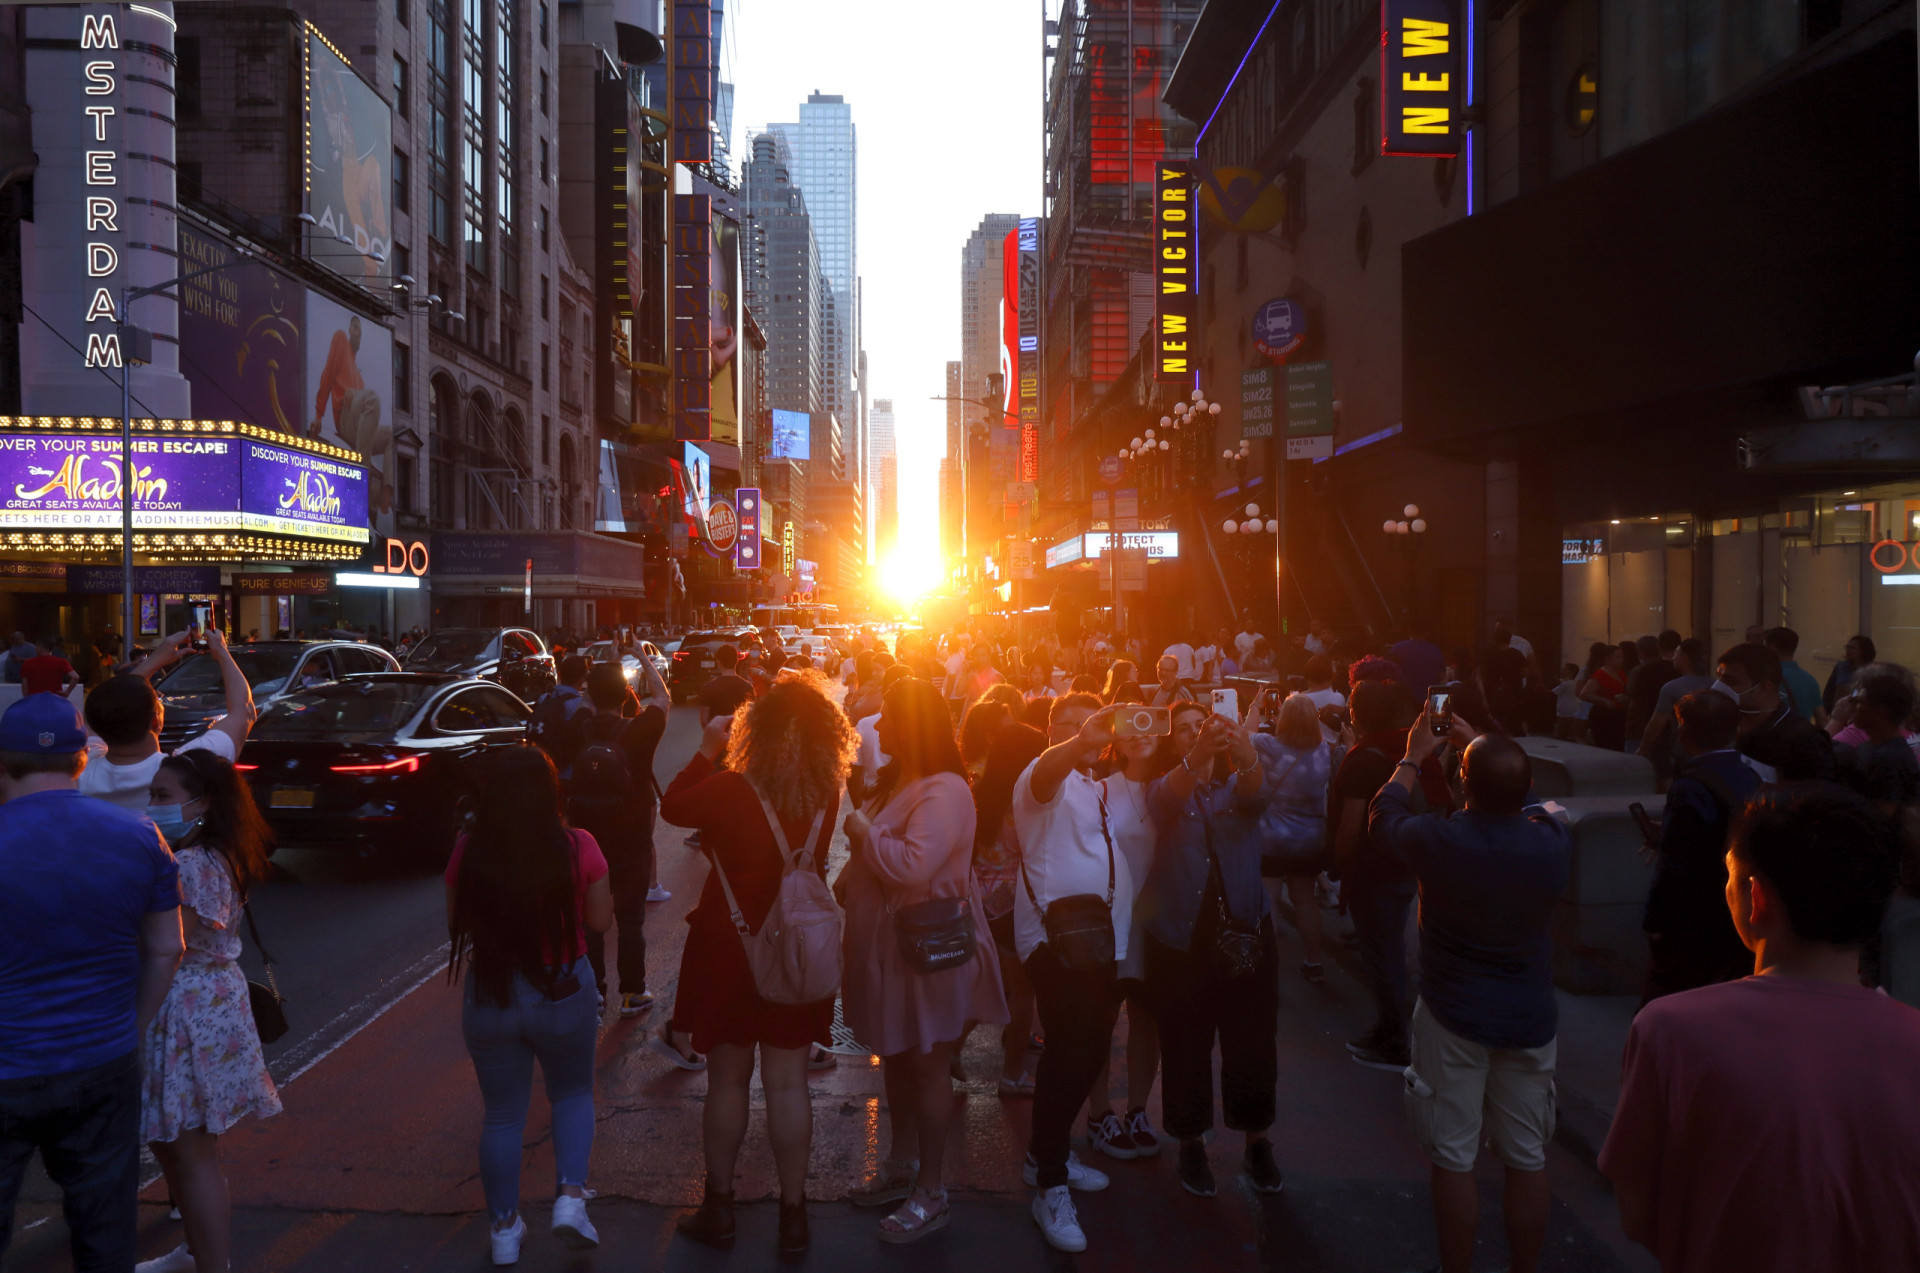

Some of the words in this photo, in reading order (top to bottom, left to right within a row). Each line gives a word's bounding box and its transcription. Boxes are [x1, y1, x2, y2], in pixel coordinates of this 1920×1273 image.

[678, 0, 706, 160] ADAME
[1402, 18, 1450, 135] NEW
[81, 14, 122, 368] MSTERDAM
[1019, 218, 1037, 251] NEW
[1163, 169, 1187, 294] VICTORY
[184, 259, 213, 292] WHAT
[219, 275, 238, 303] YOU
[184, 285, 212, 317] WISH
[681, 195, 704, 437] TUSSAUDS
[1163, 314, 1187, 373] NEW
[1257, 343, 1267, 353] NO
[1268, 336, 1302, 355] STANDING
[1243, 370, 1267, 385] SIM8
[1021, 378, 1037, 414] DUE
[1243, 387, 1272, 403] SIM22
[1243, 422, 1272, 438] SIM30
[41, 440, 86, 451] YOUR
[91, 441, 159, 453] SUMMER
[163, 442, 228, 454] ESCAPE!
[251, 446, 289, 464] DISCOVER
[290, 456, 310, 468] YOUR
[310, 461, 337, 475] SUMMER
[337, 466, 362, 480] ESCAPE!
[15, 454, 168, 500] Aladdin
[279, 470, 341, 516] Aladdin
[6, 500, 42, 509] GREAT
[45, 500, 79, 509] SEATS
[82, 501, 140, 510] AVAILAE
[143, 502, 182, 510] TODAY!
[34, 514, 68, 523] HERE
[73, 514, 91, 523] OR
[97, 514, 112, 523] AT
[275, 507, 292, 517] GREAT
[292, 510, 306, 520] SEATS
[710, 511, 728, 528] DAVE
[727, 511, 734, 523] &
[279, 521, 292, 530] GET
[292, 522, 315, 534] TICKETS
[315, 525, 329, 536] HERE
[330, 528, 338, 537] OR
[17, 564, 56, 575] BROADWAY
[86, 570, 139, 580] "MUSICL
[146, 570, 196, 580] COMEDY
